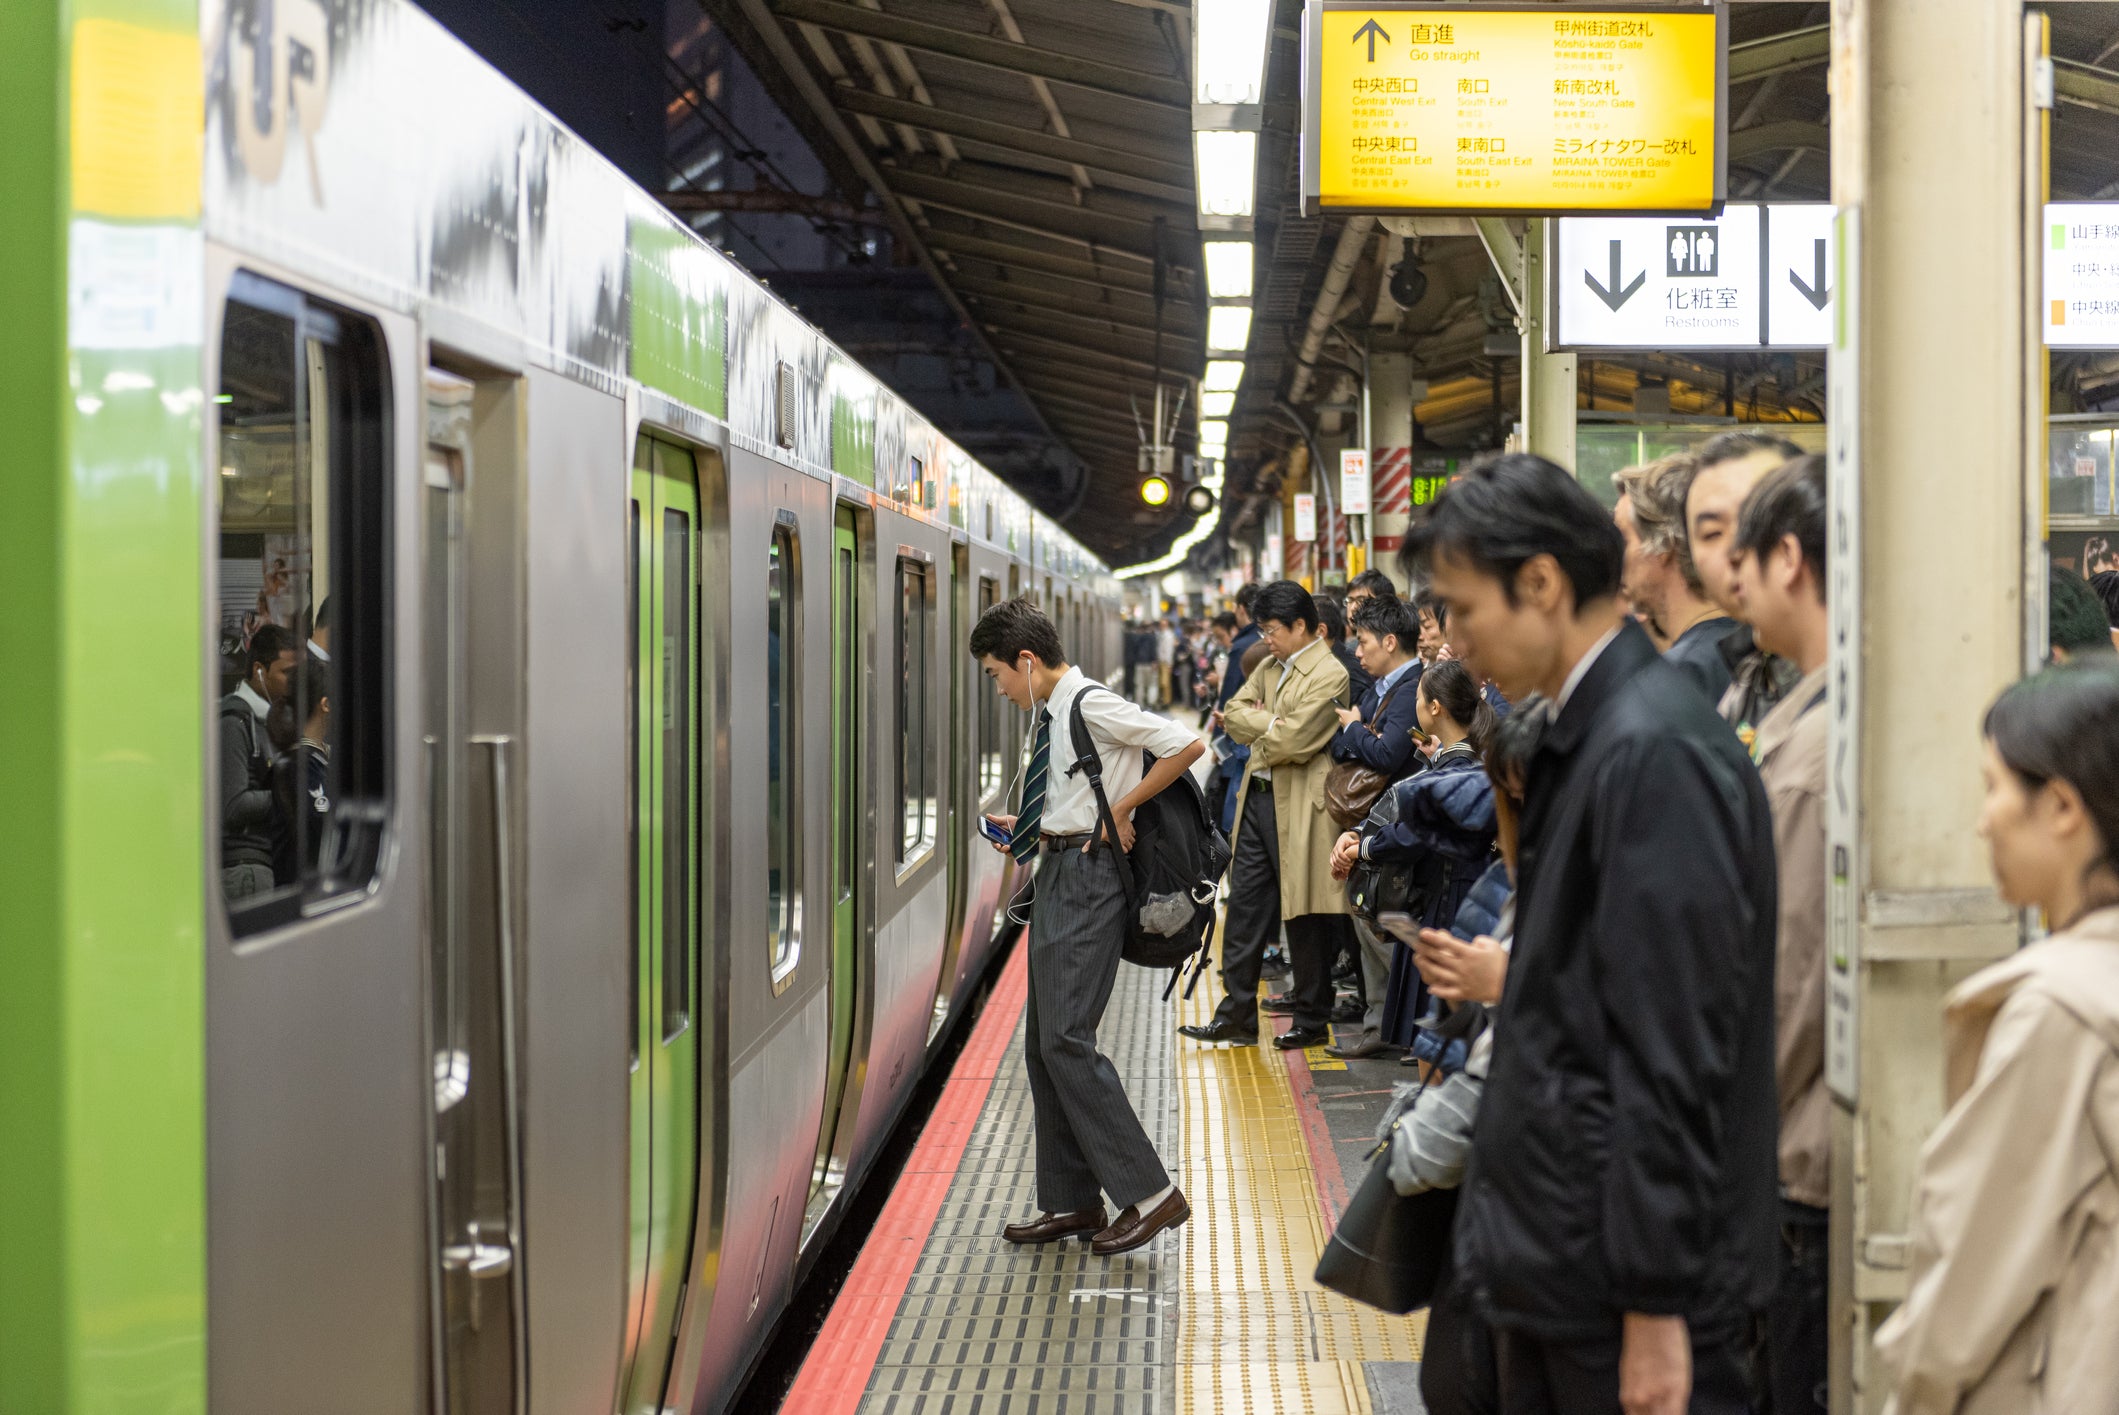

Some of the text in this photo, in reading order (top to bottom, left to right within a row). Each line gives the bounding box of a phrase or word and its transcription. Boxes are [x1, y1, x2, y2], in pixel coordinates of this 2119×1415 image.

[1411, 24, 1454, 44] 直進
[1554, 20, 1654, 37] 甲州街道改札
[1618, 40, 1644, 50] Gate
[1409, 48, 1480, 64] Go straight
[1353, 77, 1418, 93] 中央西口
[1457, 78, 1489, 94] 南口
[1554, 79, 1620, 96] 新南改札
[1352, 96, 1436, 106] Central West Exit
[1457, 97, 1508, 106] South Exit
[1554, 98, 1635, 108] New South Gate
[1352, 136, 1417, 152] 中央東口
[1457, 137, 1505, 153] 東南口
[1553, 138, 1697, 155] ミライナタワー改札
[1351, 155, 1433, 165] Central East Exit
[1456, 156, 1533, 166] South East Exit
[1553, 157, 1671, 168] MIRAINA TOWER Gate
[1596, 170, 1629, 178] TOWER
[2072, 224, 2119, 239] 山手線
[1666, 287, 1738, 310] 化粧室
[2072, 300, 2119, 315] 中央線
[1665, 315, 1740, 328] Restrooms
